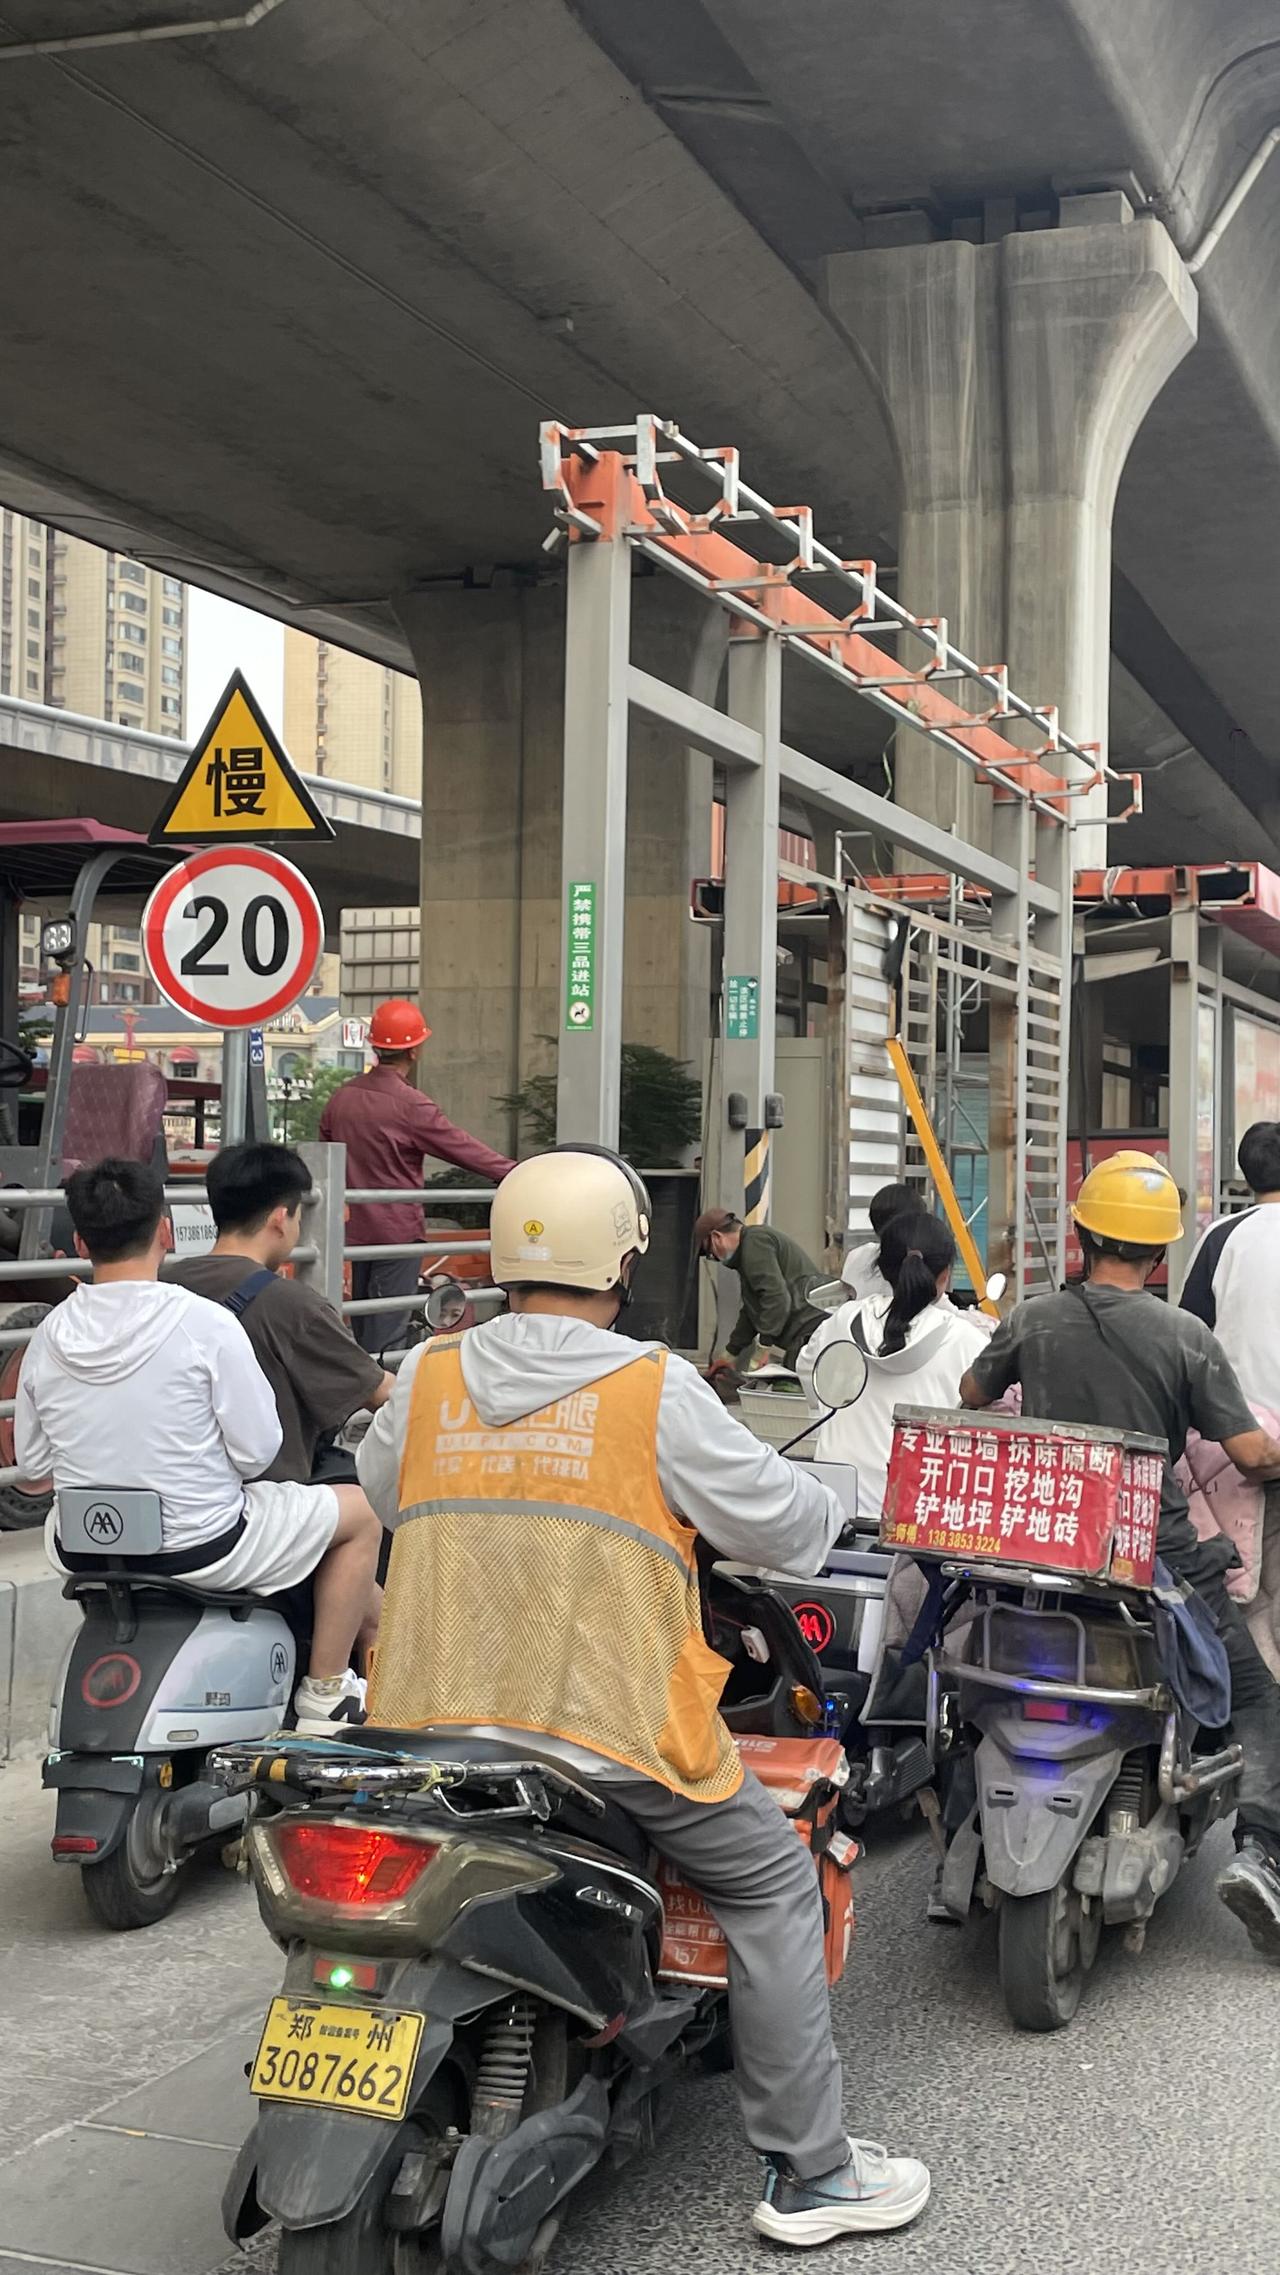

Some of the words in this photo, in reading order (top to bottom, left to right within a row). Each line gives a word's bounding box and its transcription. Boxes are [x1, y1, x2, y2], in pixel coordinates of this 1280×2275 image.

[205, 746, 268, 817] 慢
[180, 894, 290, 977] 20
[570, 884, 593, 997] 严禁携带三品进站
[919, 1457, 995, 1496] 开门口
[1004, 1466, 1084, 1509] 挖地沟
[1007, 1434, 1115, 1476] 拆除隔断
[914, 1491, 994, 1535] 铲地坪
[999, 1503, 1080, 1547] 铲地砖
[287, 2012, 316, 2043] 郑
[366, 2024, 394, 2053] 州
[258, 2045, 403, 2107] 3087662
